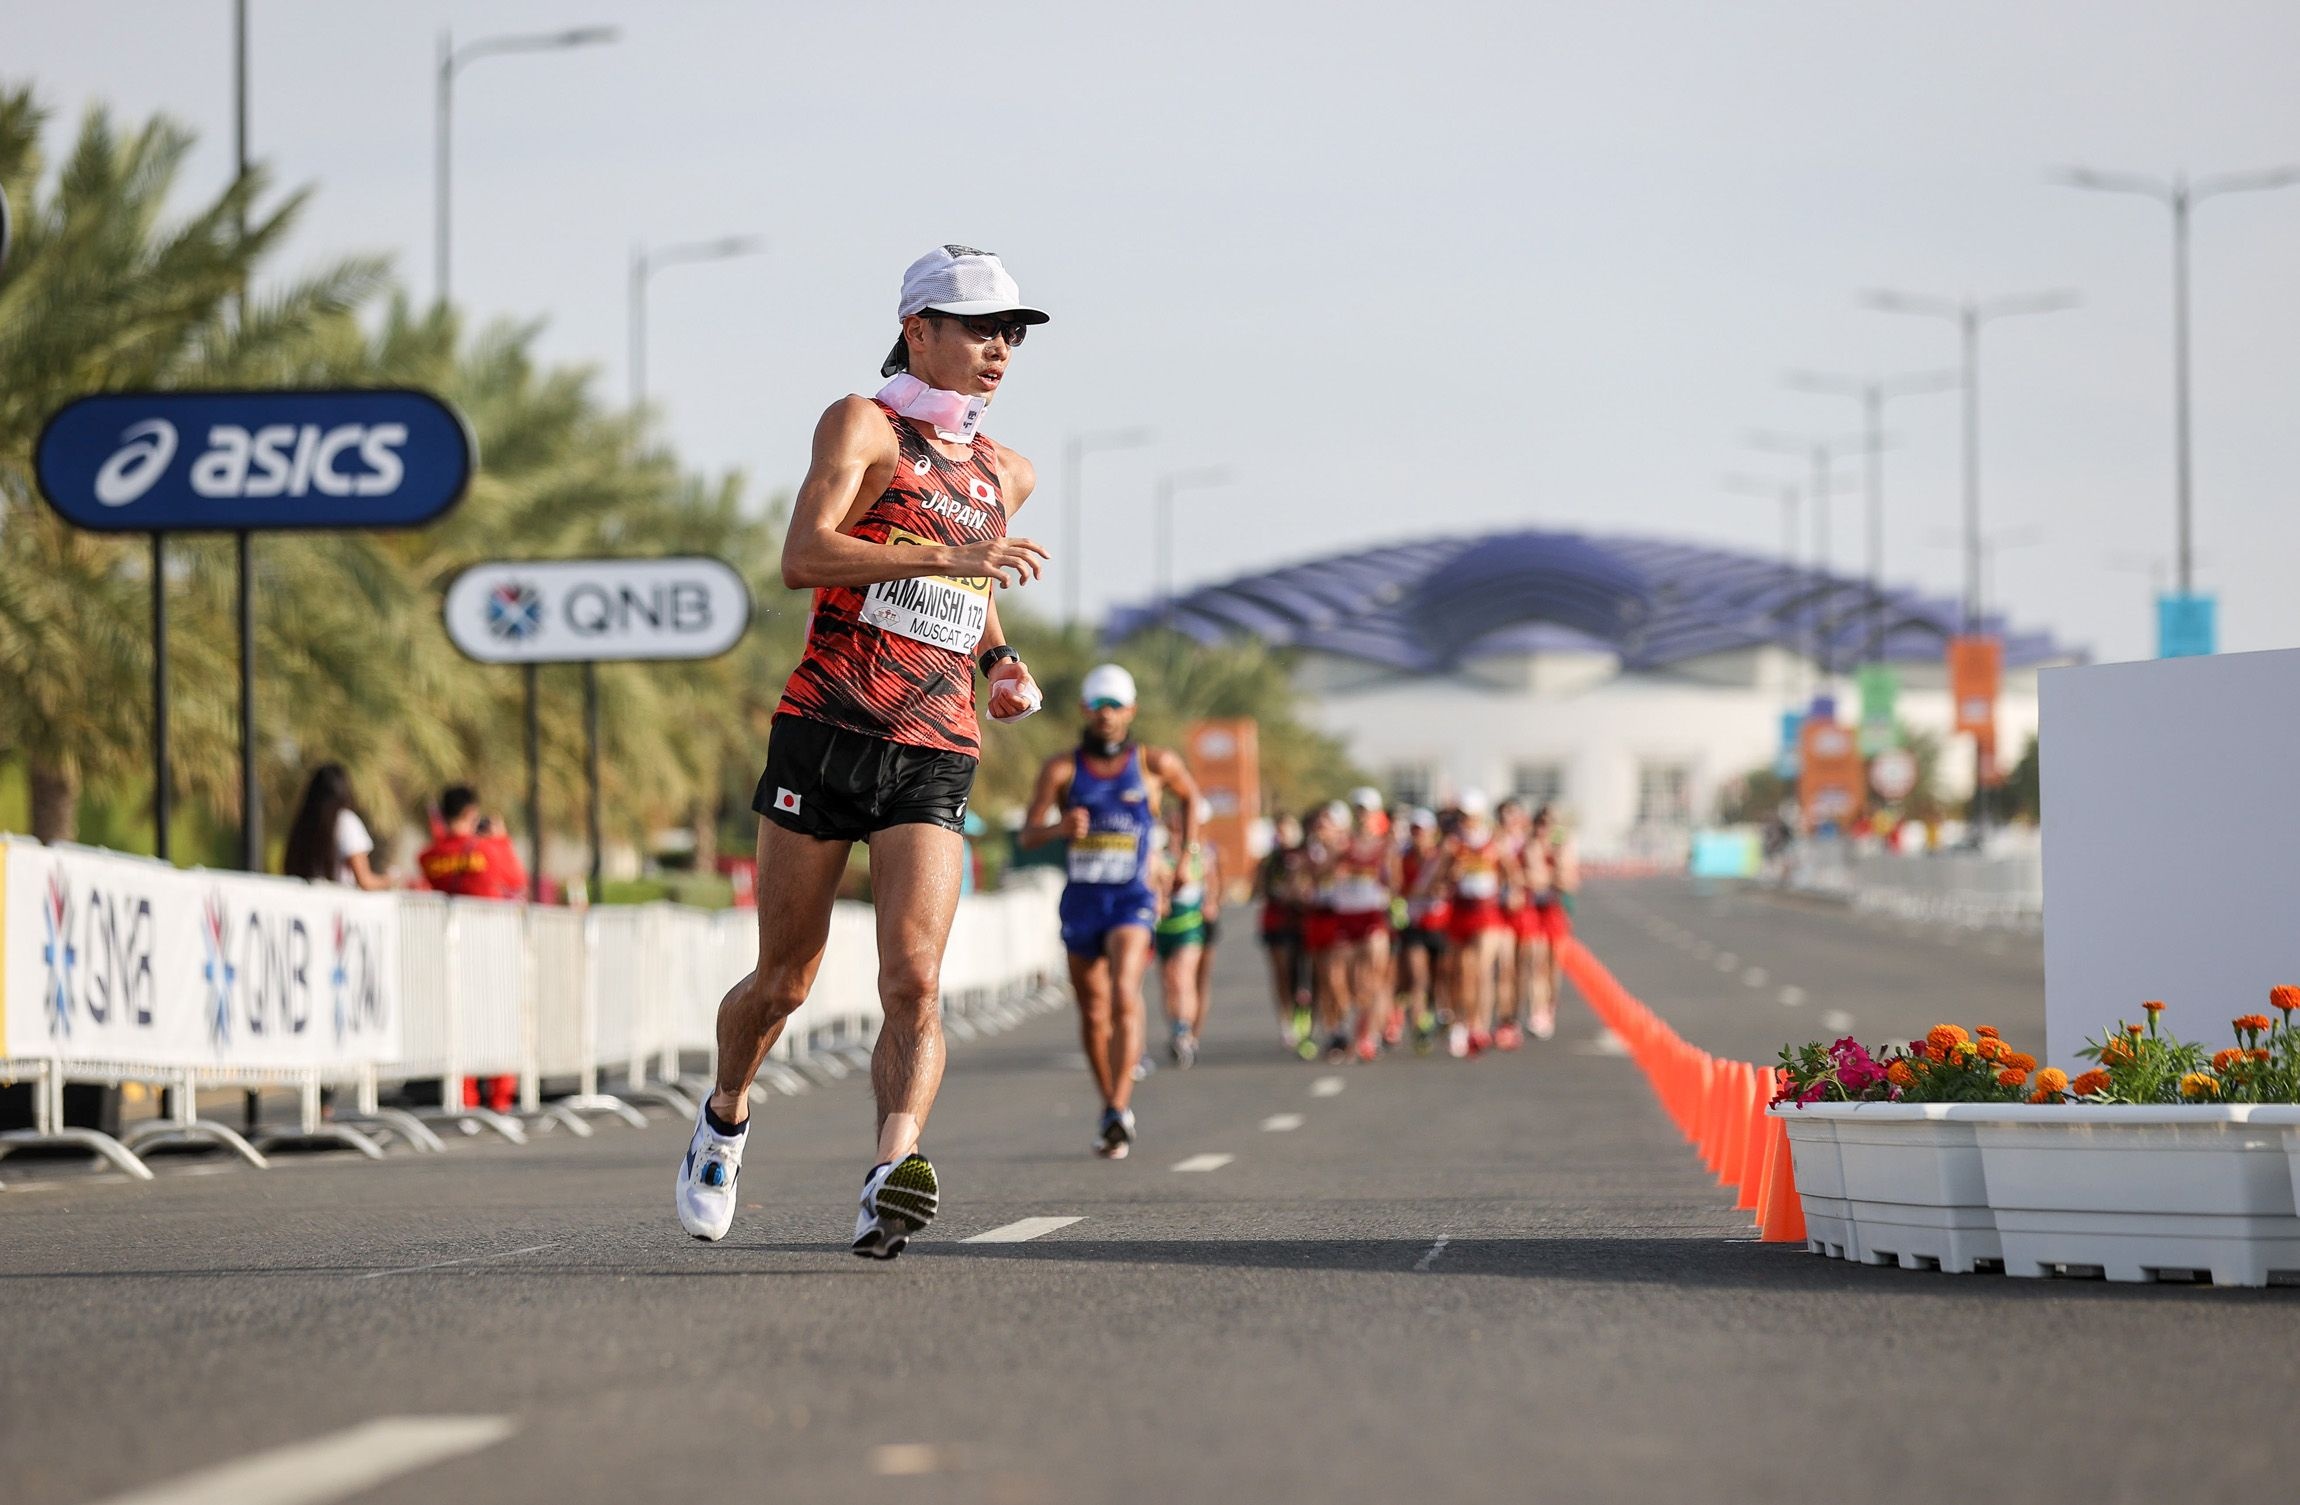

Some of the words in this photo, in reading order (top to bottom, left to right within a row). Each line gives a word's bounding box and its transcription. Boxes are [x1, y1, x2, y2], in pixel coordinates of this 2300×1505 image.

[189, 424, 409, 498] asics
[921, 489, 988, 530] JAPAN
[562, 581, 713, 638] QNB
[909, 617, 962, 647] MUSCAT
[967, 604, 983, 630] 172
[86, 888, 154, 1025] QNB
[242, 910, 310, 1035] QNB
